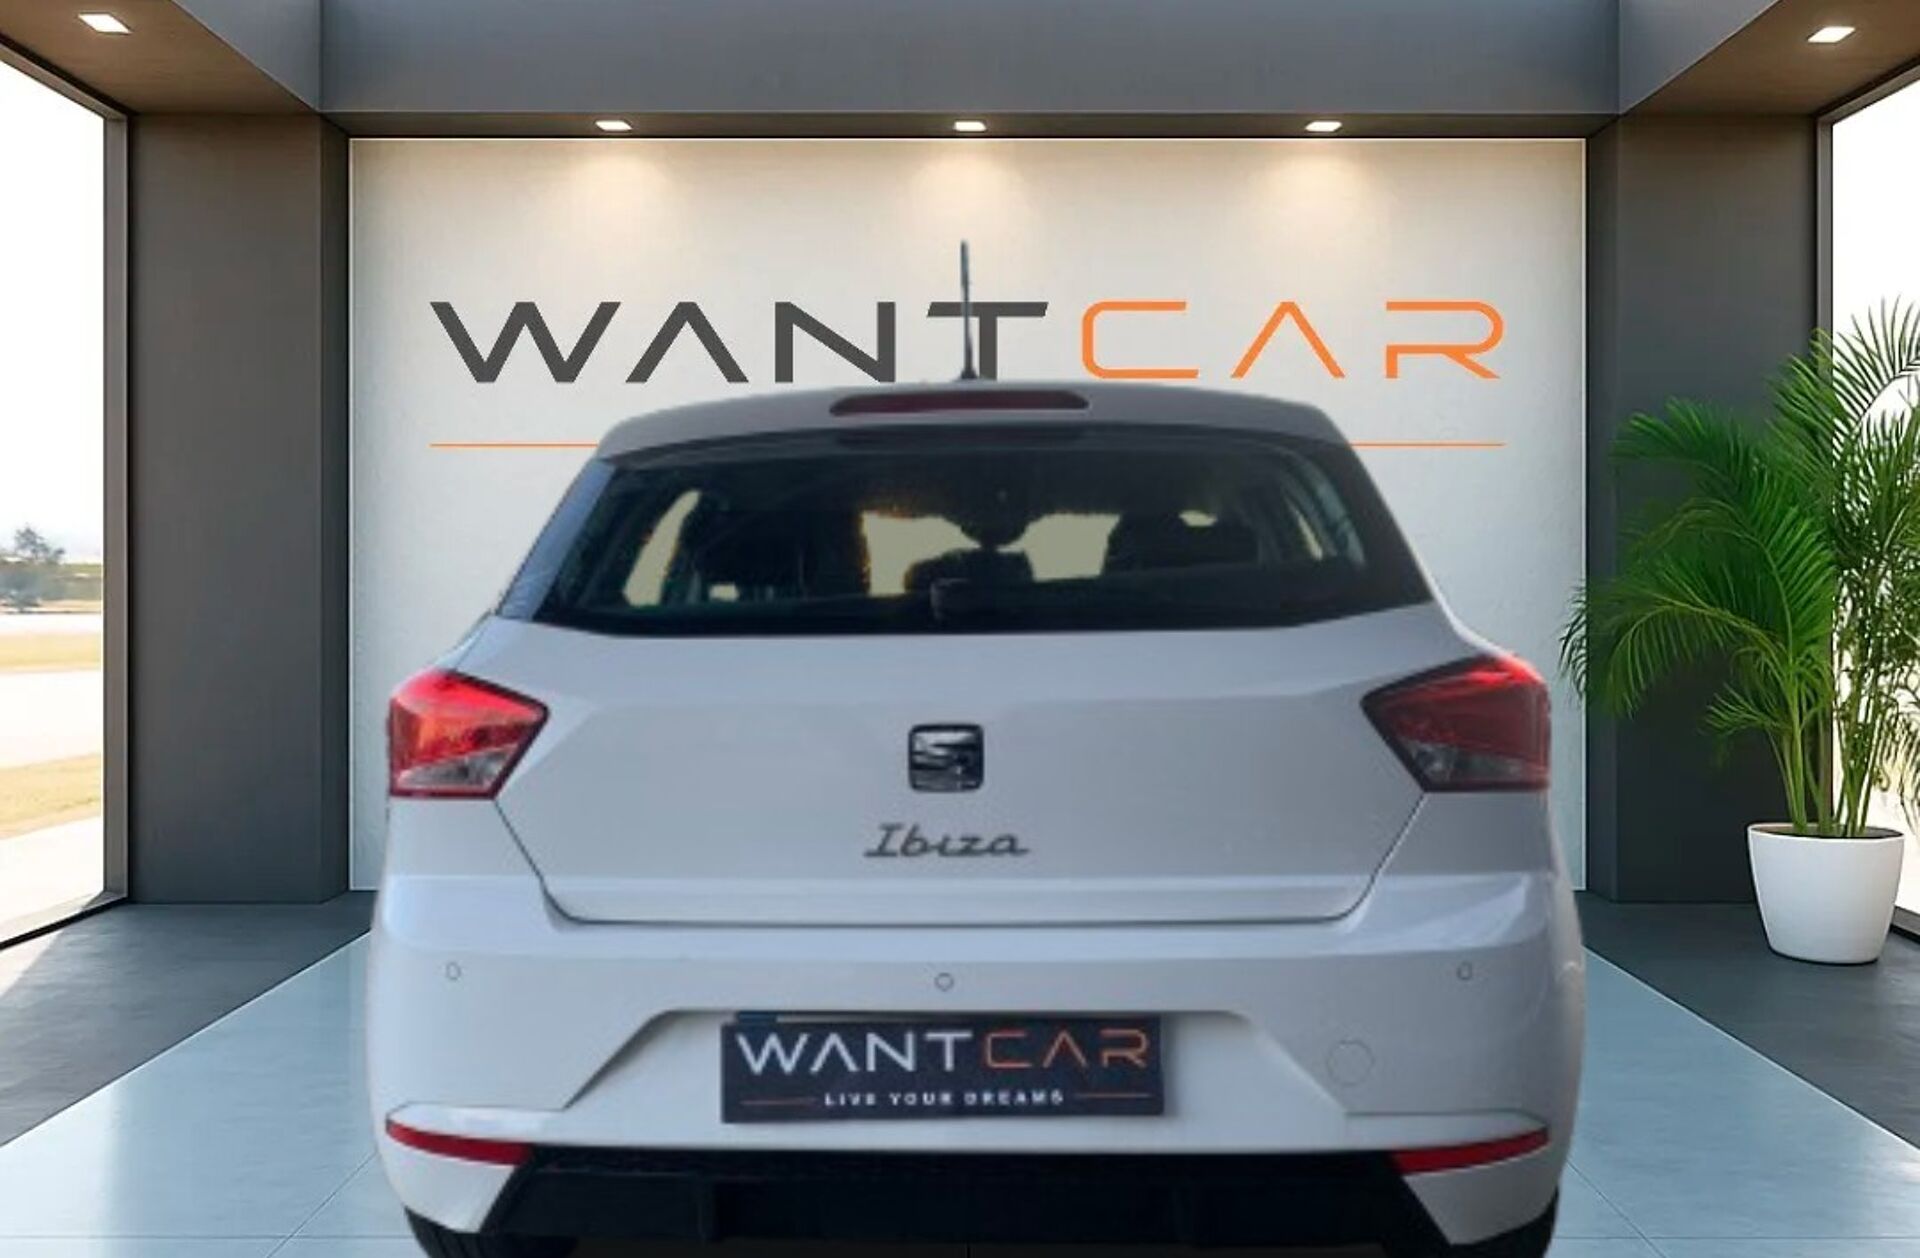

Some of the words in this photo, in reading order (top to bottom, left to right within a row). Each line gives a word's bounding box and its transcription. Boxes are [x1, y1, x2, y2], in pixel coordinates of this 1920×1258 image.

[863, 823, 1030, 857] Ibiza
[825, 1093, 876, 1107] LIVE
[890, 1091, 953, 1107] YOUR
[964, 1090, 1064, 1106] DREAMS
